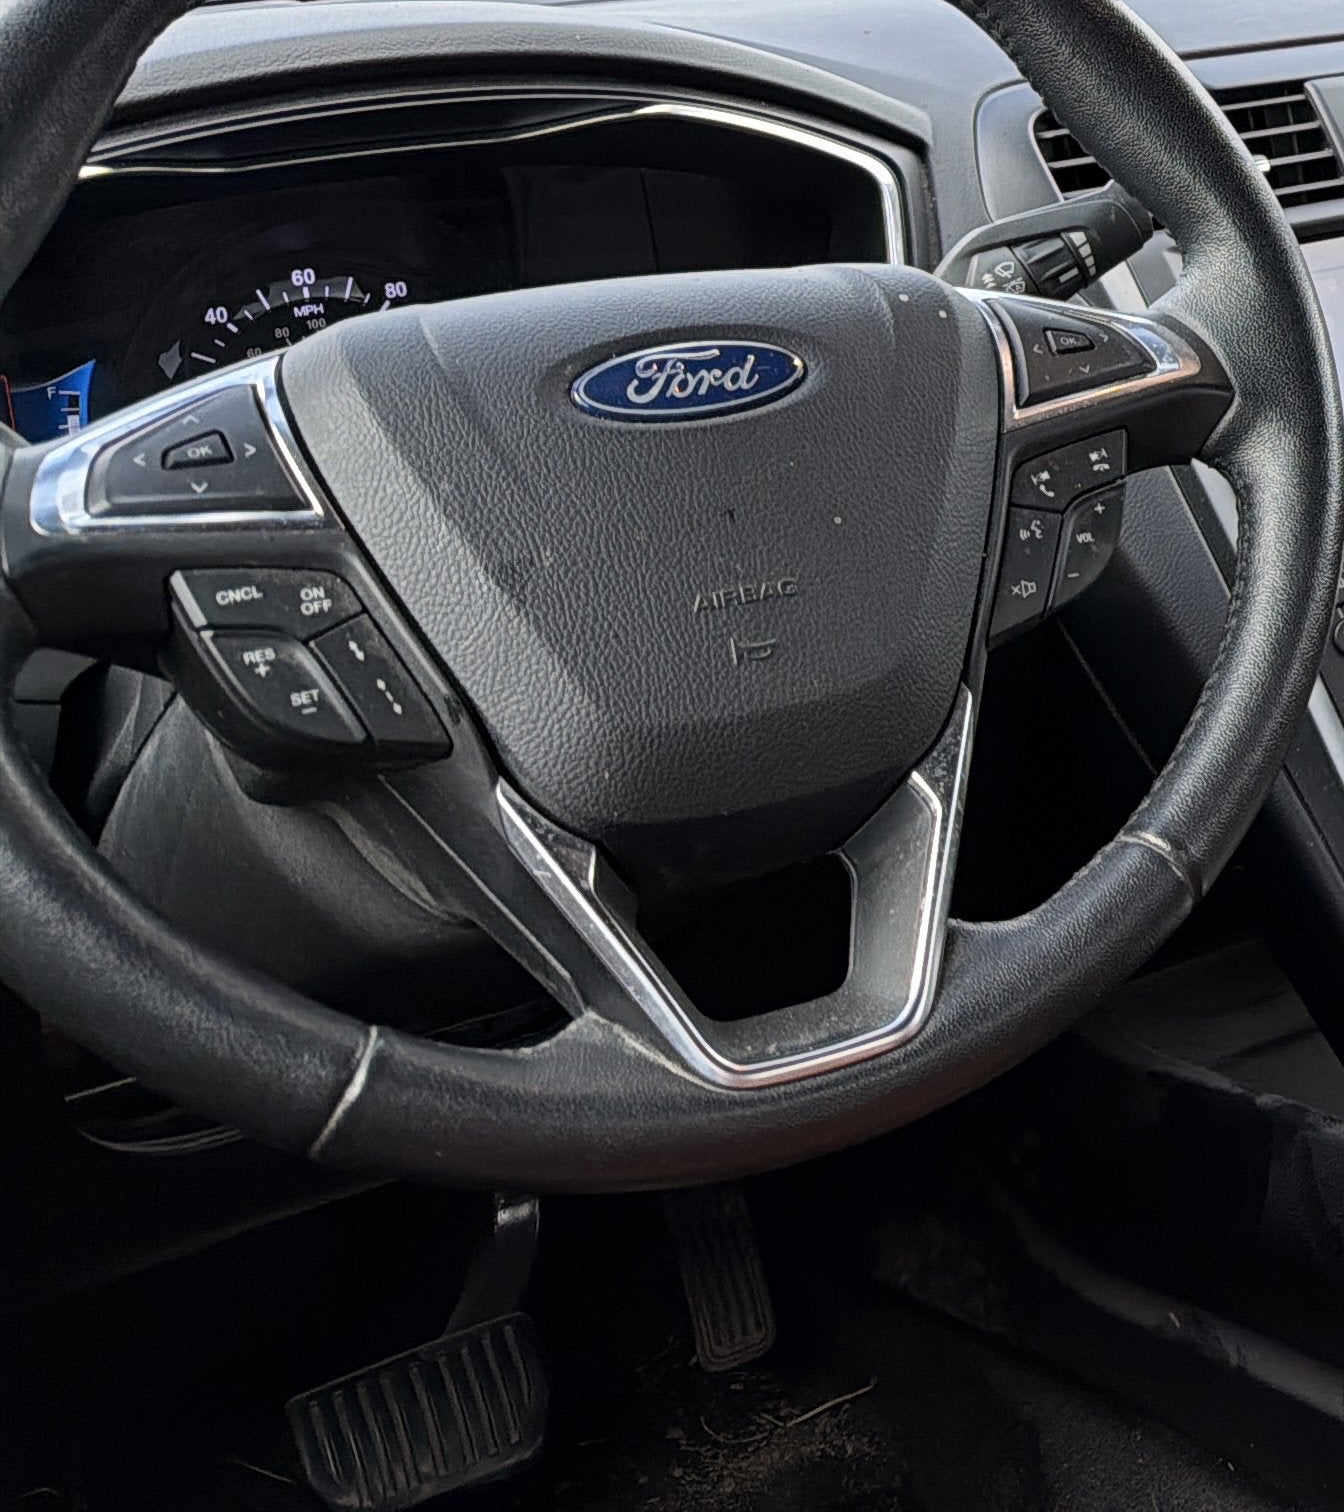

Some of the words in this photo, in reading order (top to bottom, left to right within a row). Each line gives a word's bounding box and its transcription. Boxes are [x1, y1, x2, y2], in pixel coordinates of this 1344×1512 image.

[291, 268, 316, 286] 60
[385, 280, 408, 299] 80
[204, 306, 229, 325] 40
[293, 302, 325, 318] MPH
[306, 317, 327, 331] 100
[274, 325, 290, 340] 80
[1060, 336, 1078, 346] OK
[247, 347, 262, 360] 60
[625, 347, 759, 405] Ford
[47, 386, 56, 400] F
[187, 444, 213, 459] OK
[1076, 532, 1096, 543] VOL
[216, 587, 263, 606] CNCL
[300, 587, 325, 601] ON
[694, 579, 798, 614] AIRBAG
[300, 599, 332, 616] OFF
[243, 648, 276, 663] RES
[290, 689, 321, 706] SET
